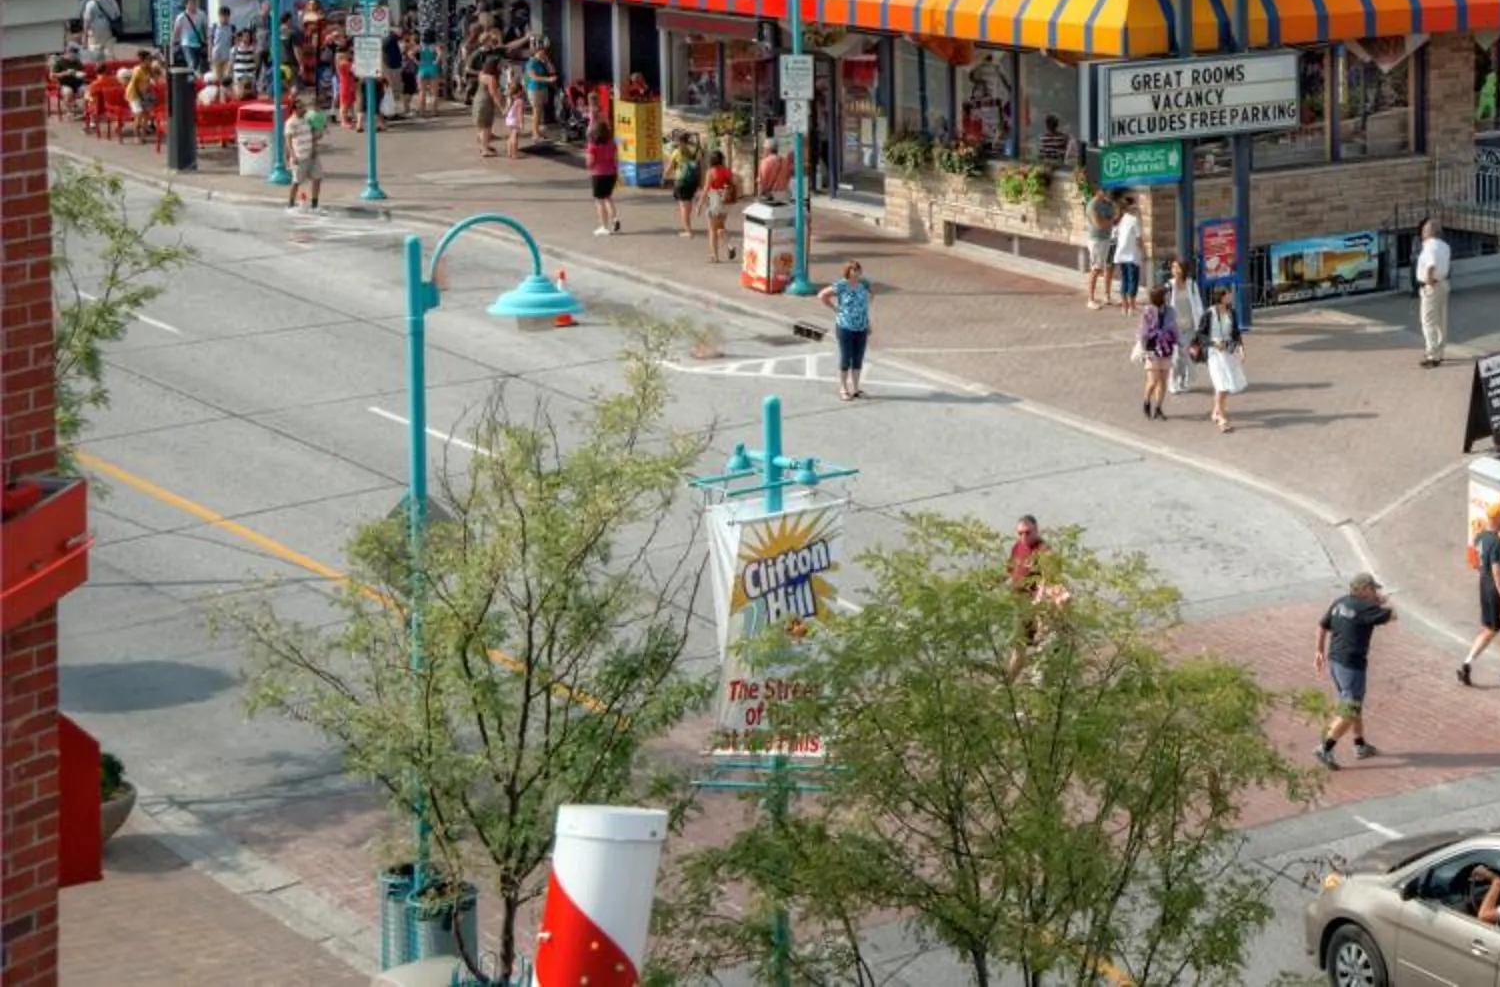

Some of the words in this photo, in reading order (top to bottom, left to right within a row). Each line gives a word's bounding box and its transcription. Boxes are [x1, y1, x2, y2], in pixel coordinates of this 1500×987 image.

[1131, 69, 1184, 93] GREAT
[1191, 64, 1246, 86] ROOMS
[1151, 88, 1226, 112] VACANCY
[1111, 112, 1187, 137] INCLUDES
[1190, 108, 1229, 129] FREE
[1230, 103, 1298, 124] PARKING
[743, 537, 832, 599] Clifton
[767, 575, 817, 624] Hill
[729, 679, 760, 701] The
[745, 701, 766, 726] of
